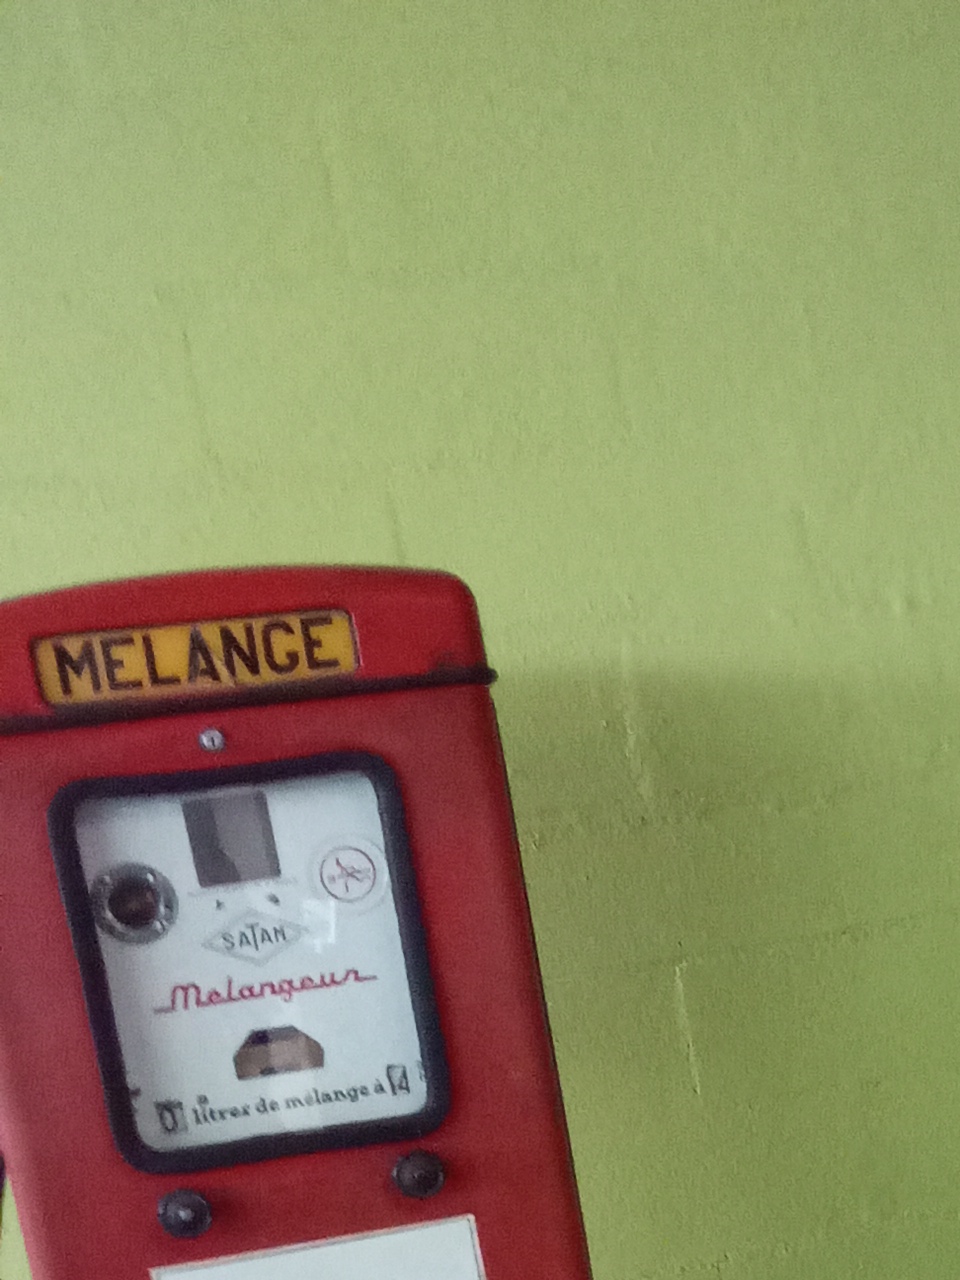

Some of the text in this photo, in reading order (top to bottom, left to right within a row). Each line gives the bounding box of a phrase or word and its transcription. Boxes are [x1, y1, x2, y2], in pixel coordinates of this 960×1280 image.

[53, 617, 342, 695] MELANGE
[221, 922, 287, 951] SATAN
[255, 1097, 280, 1114] de
